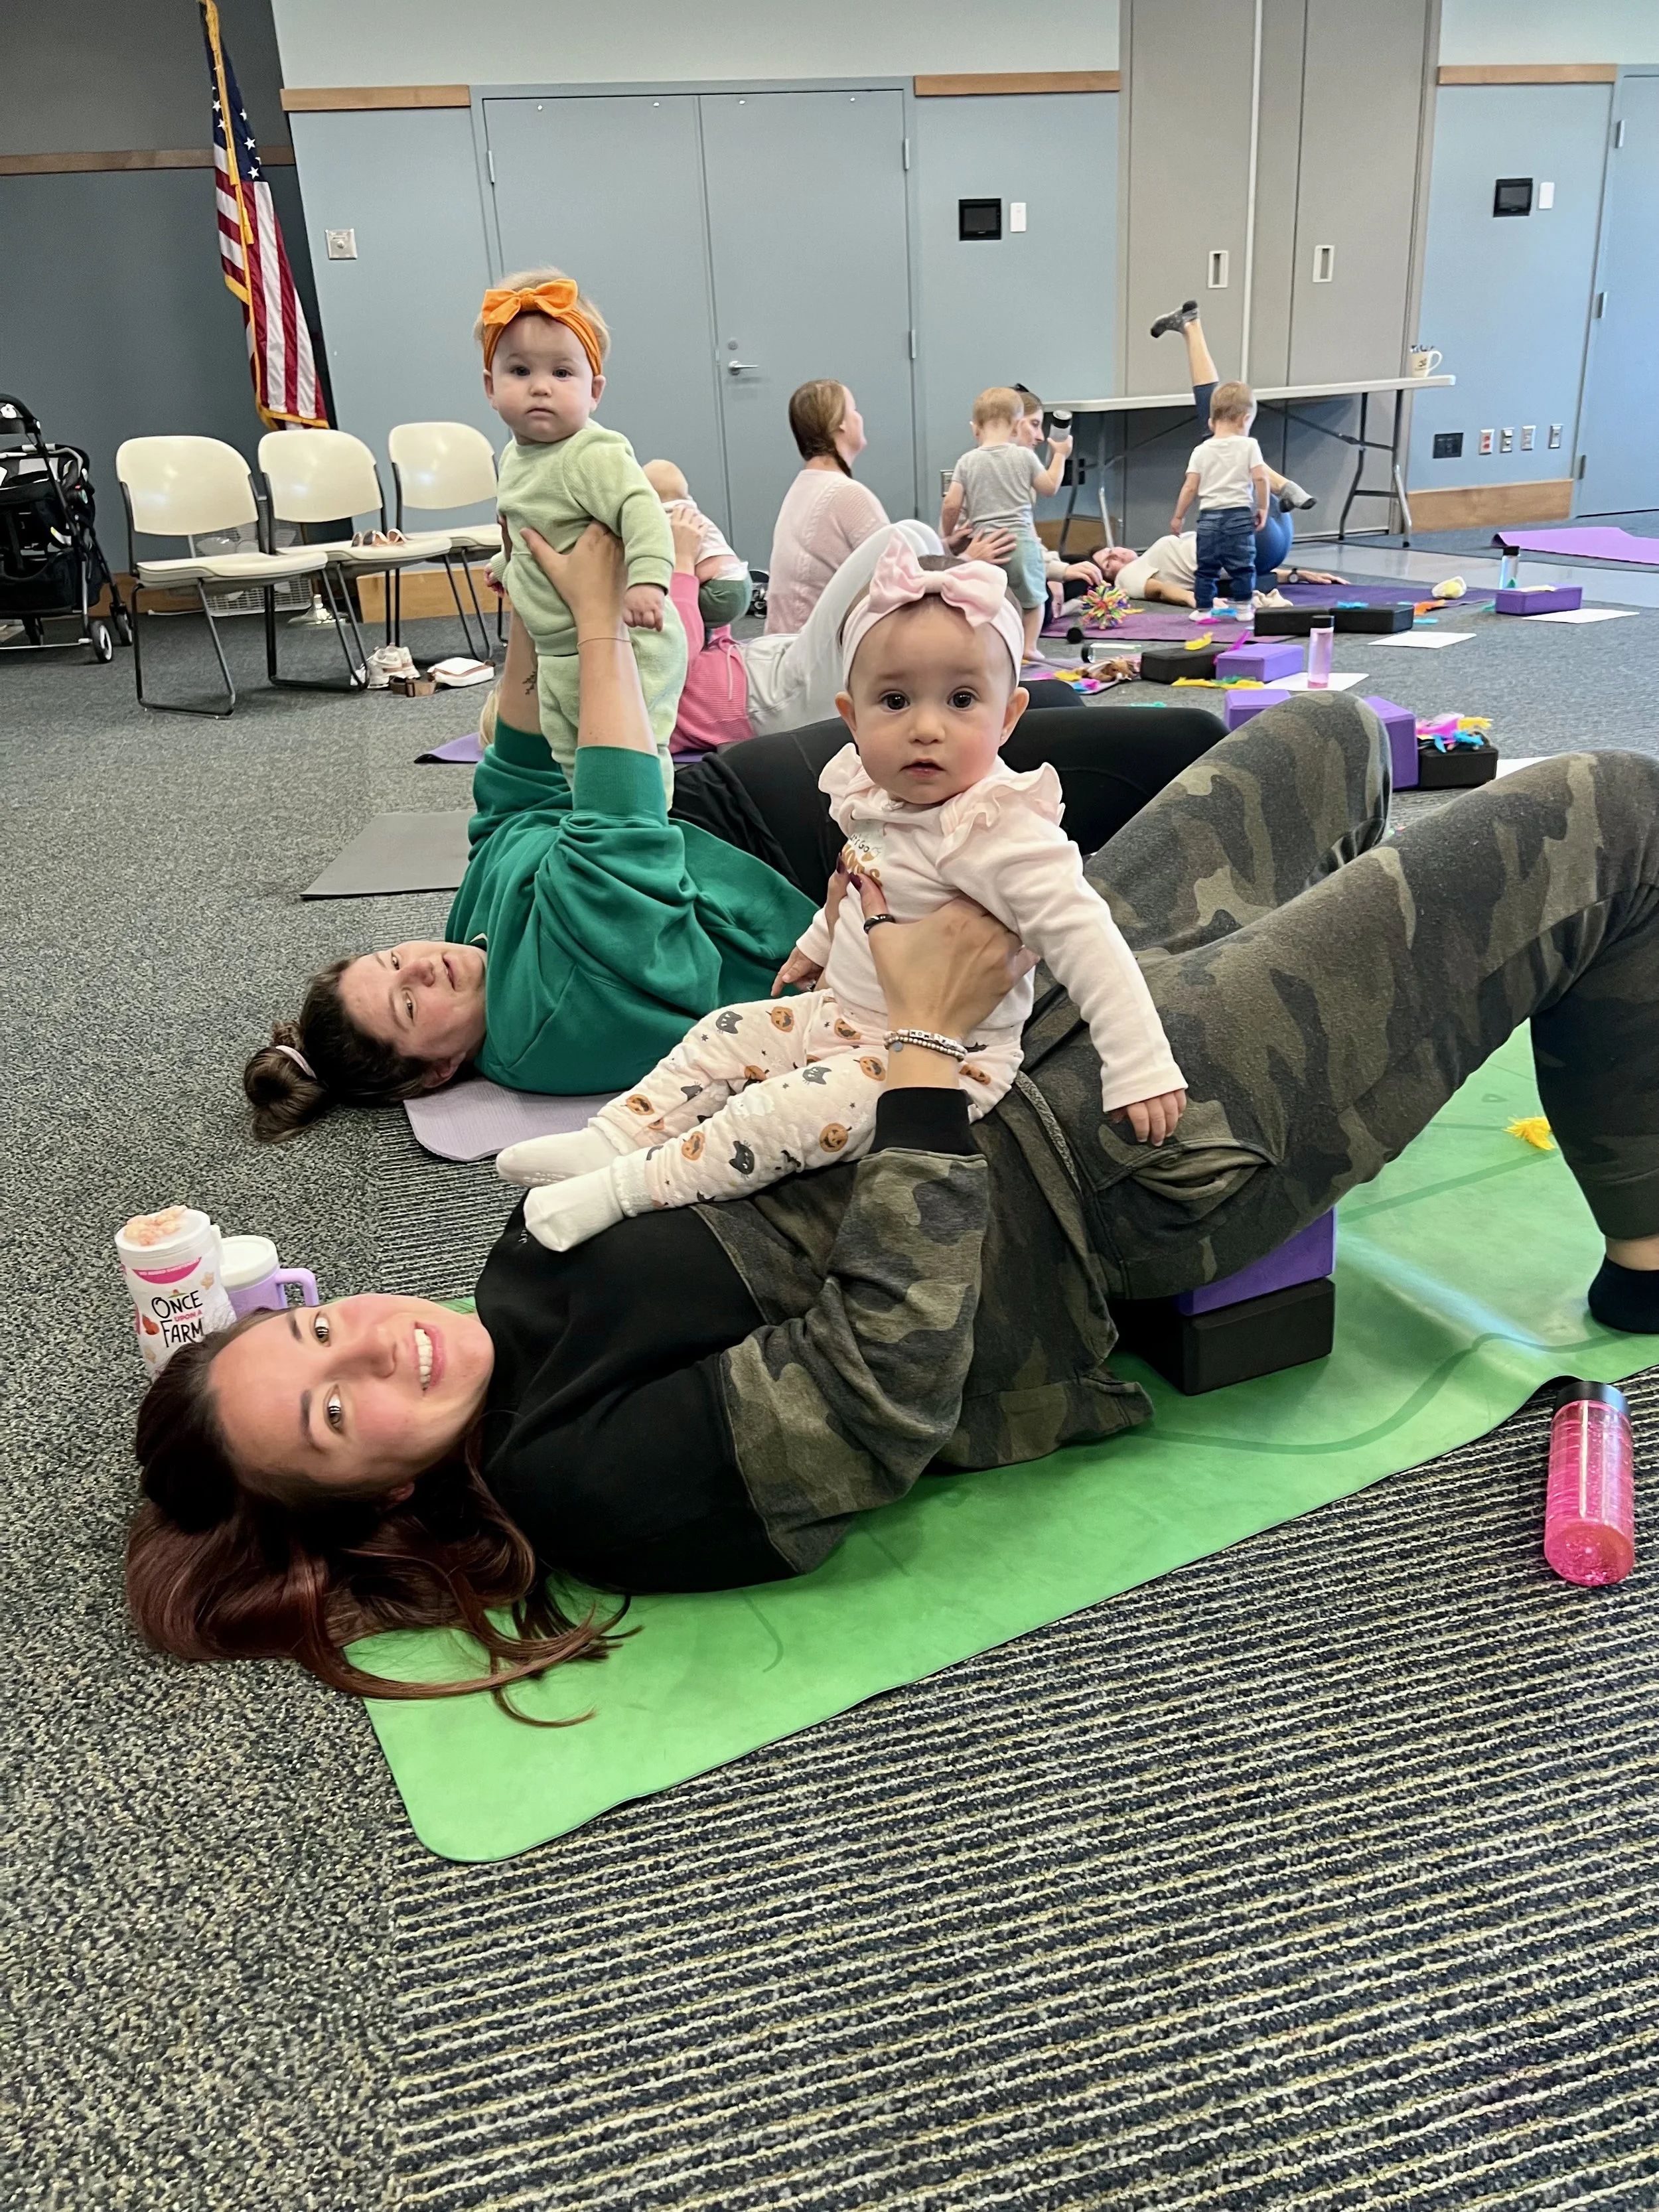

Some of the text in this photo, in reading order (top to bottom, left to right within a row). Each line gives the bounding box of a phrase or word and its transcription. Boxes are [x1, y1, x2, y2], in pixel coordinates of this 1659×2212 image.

[151, 1290, 203, 1319] ONCE
[174, 1311, 195, 1322] UPON
[160, 1318, 204, 1348] FARM
